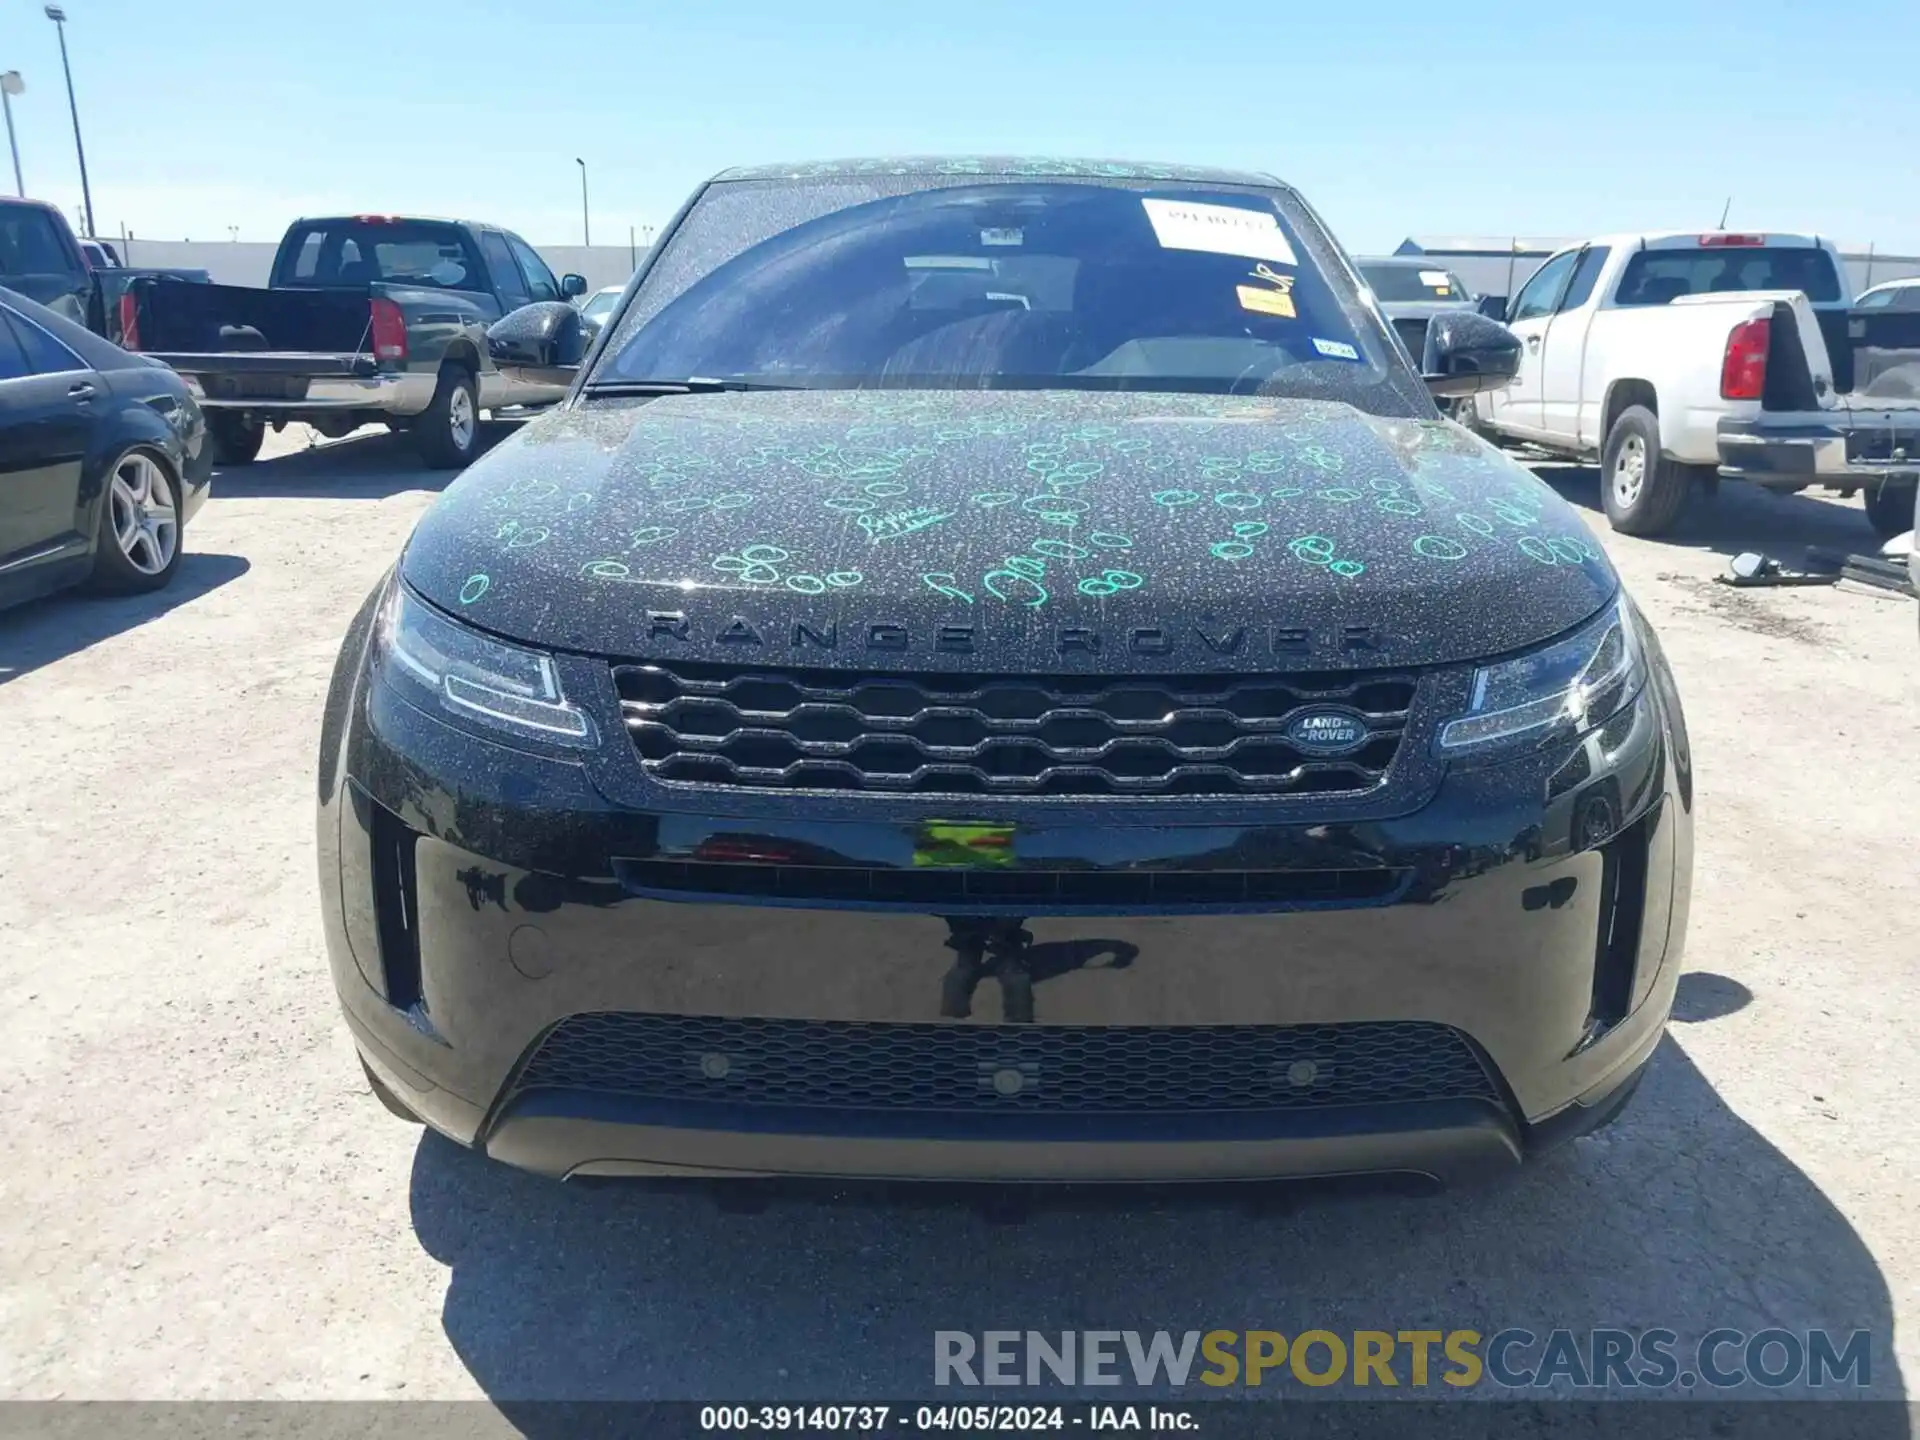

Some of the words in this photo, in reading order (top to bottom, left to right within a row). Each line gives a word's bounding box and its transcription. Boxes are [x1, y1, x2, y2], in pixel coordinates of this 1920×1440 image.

[648, 610, 975, 651] RANGE
[1055, 627, 1384, 655] ROVER
[1302, 718, 1342, 729] LAND
[1308, 729, 1355, 741] ROVER
